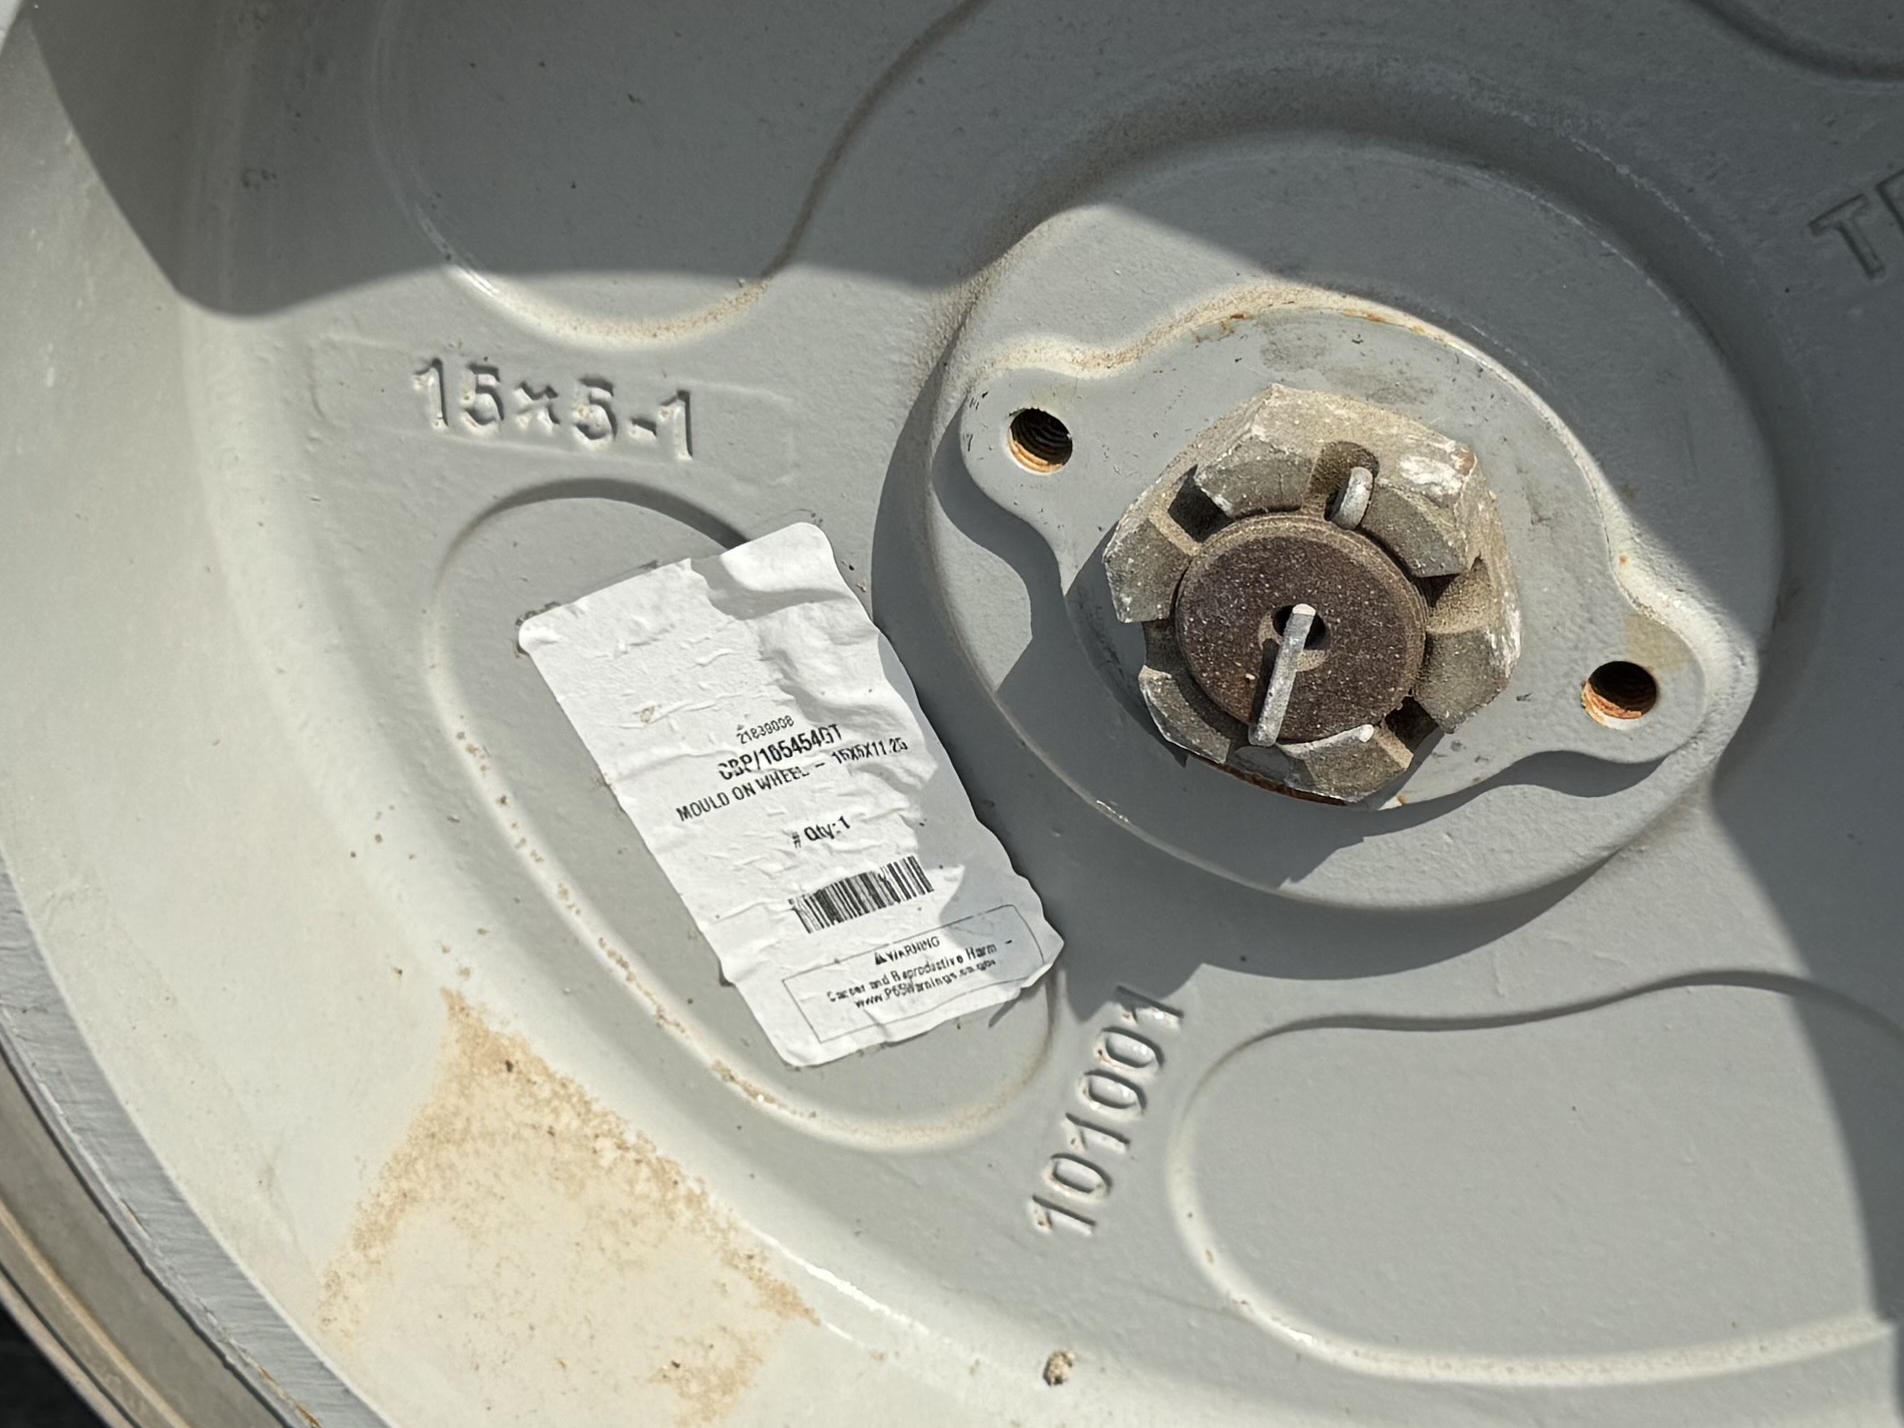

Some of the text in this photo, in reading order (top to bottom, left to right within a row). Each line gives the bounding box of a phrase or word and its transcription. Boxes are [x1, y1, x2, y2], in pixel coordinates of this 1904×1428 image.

[675, 791, 730, 822] MOULD
[731, 781, 757, 801] ON
[755, 766, 810, 791] WHEEL
[869, 975, 890, 990] and
[892, 954, 964, 986] Reproductive
[965, 943, 998, 961] Harm
[886, 936, 941, 962] WARNING
[1032, 983, 1186, 1235] 101001
